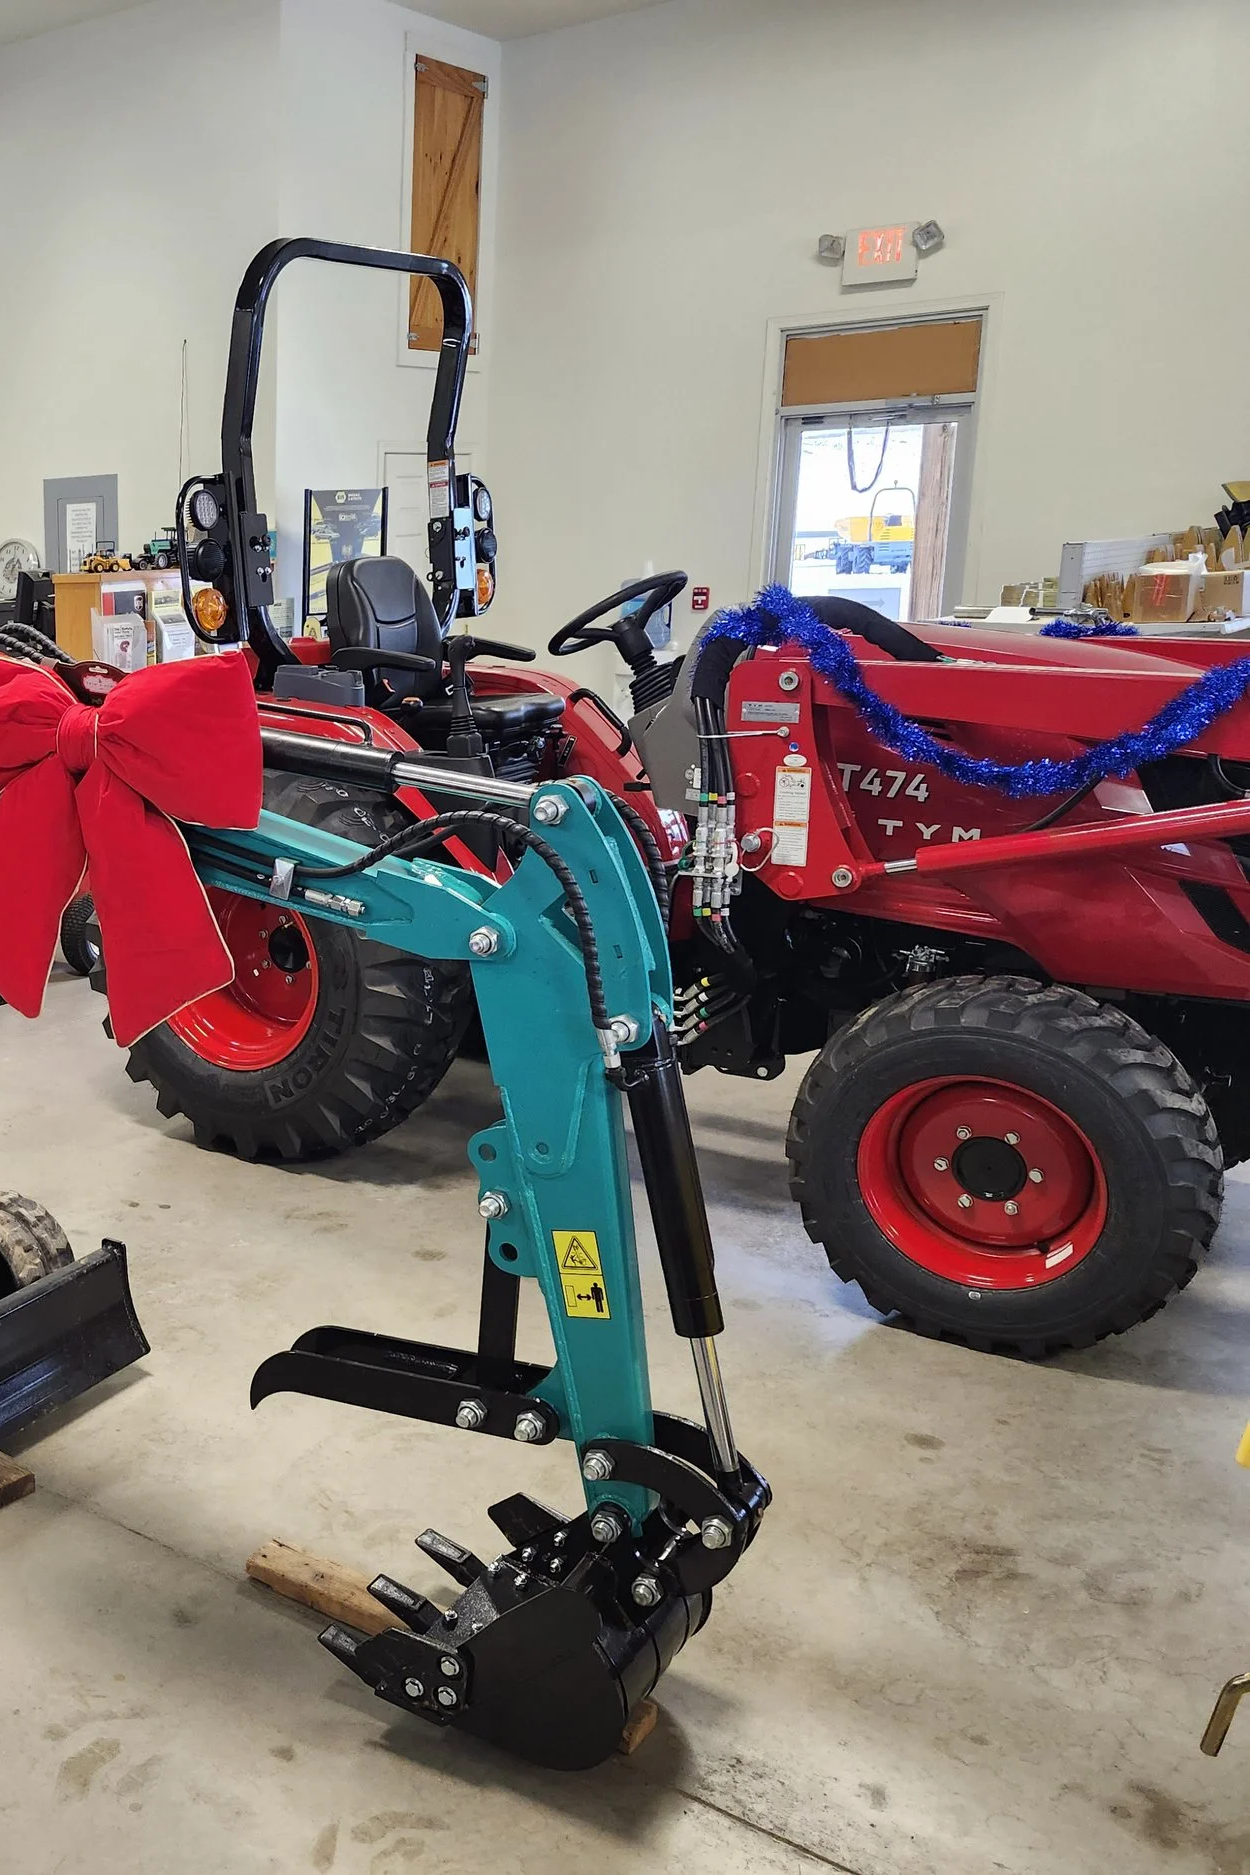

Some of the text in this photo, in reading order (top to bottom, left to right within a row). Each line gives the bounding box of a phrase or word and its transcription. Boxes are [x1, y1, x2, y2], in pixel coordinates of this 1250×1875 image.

[858, 227, 905, 266] EXIT
[837, 762, 929, 802] T474
[877, 818, 981, 843] TYM
